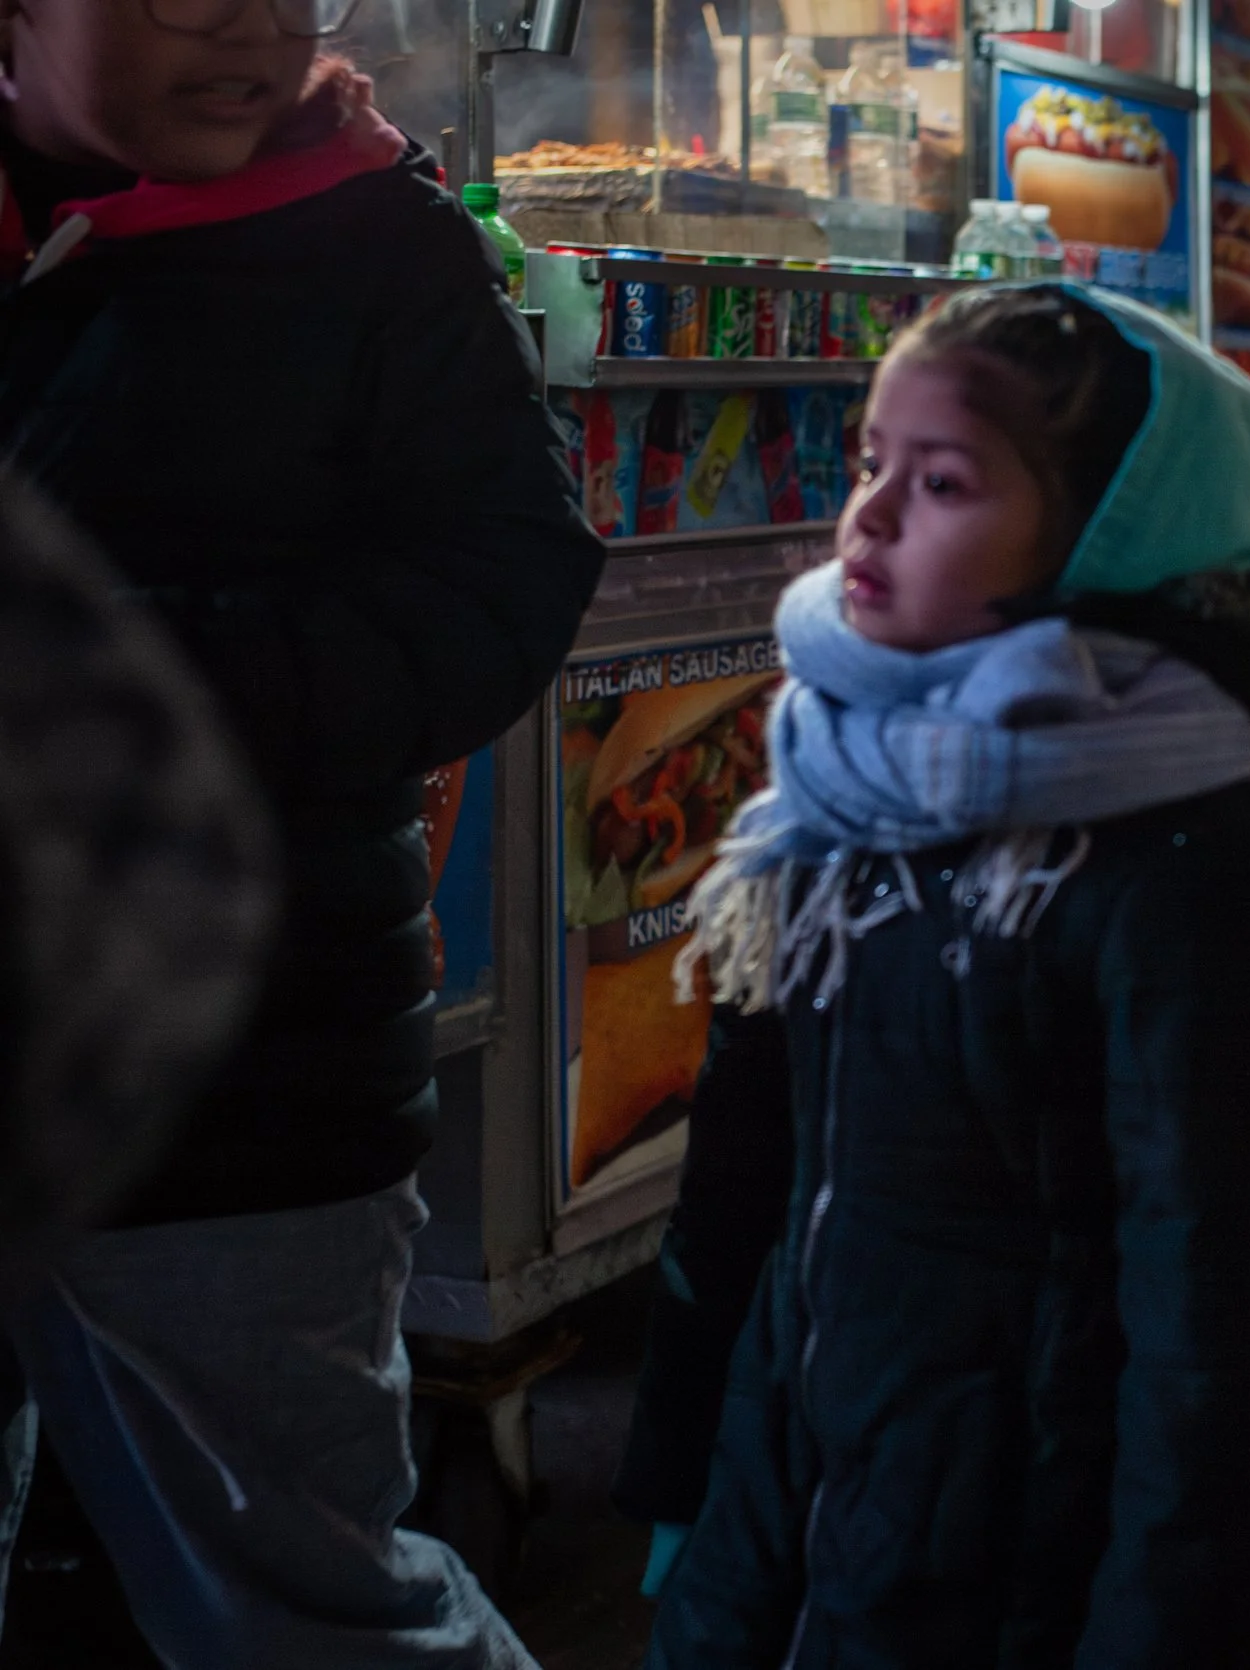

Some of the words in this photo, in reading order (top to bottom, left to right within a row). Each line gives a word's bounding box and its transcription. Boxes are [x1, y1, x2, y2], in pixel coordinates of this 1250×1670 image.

[623, 281, 647, 352] peps
[565, 655, 663, 703] ITALIAN
[628, 901, 694, 948] KNIS
